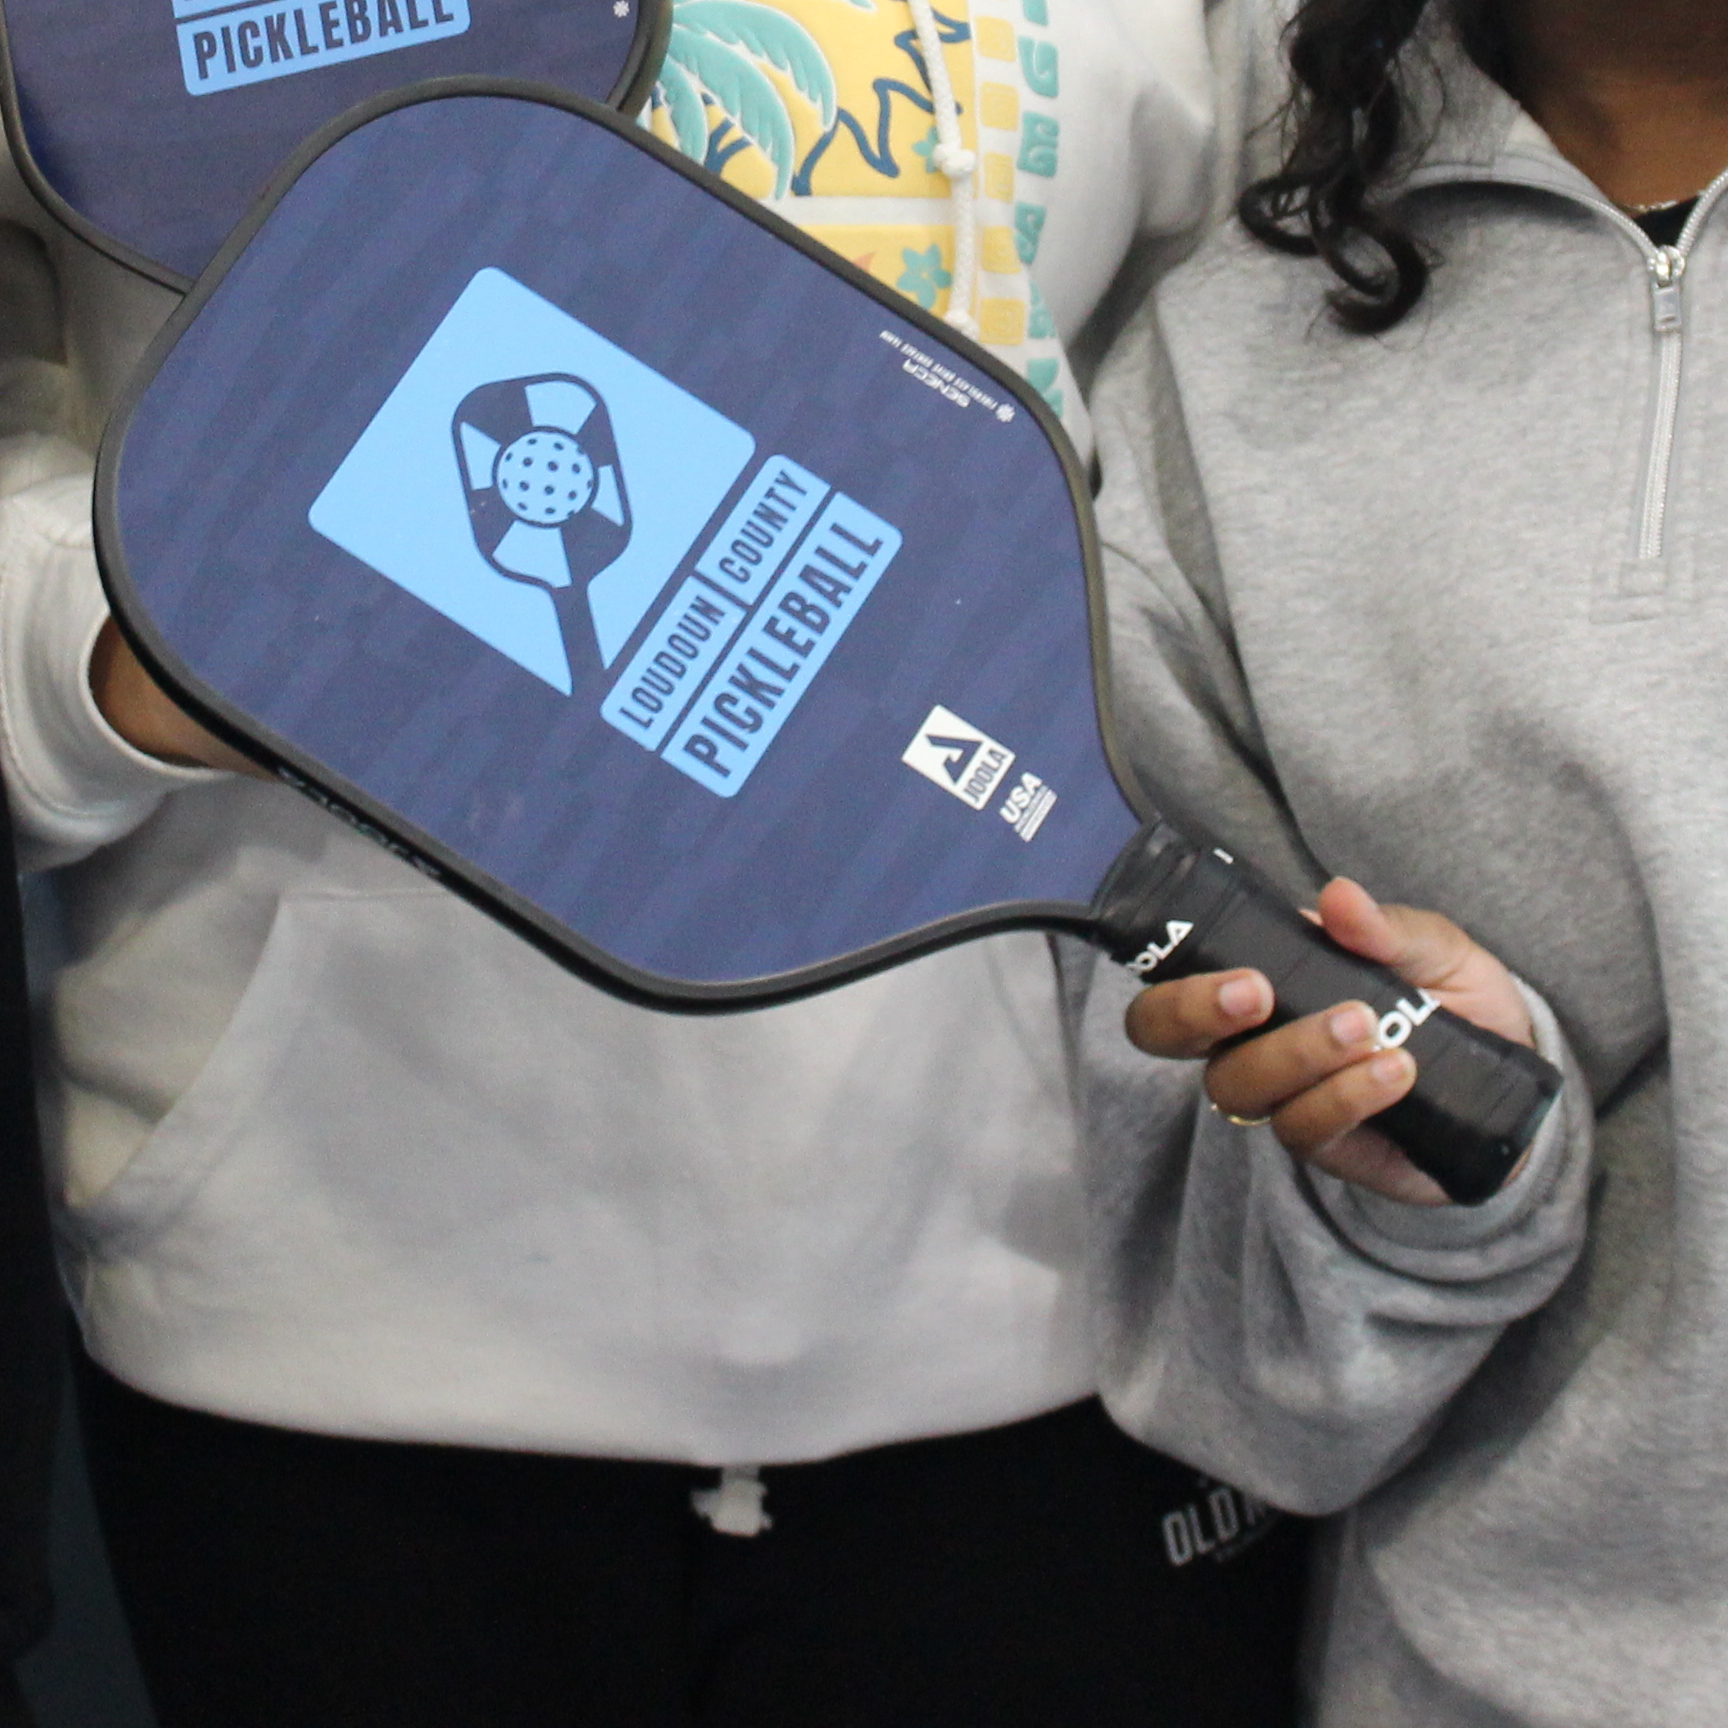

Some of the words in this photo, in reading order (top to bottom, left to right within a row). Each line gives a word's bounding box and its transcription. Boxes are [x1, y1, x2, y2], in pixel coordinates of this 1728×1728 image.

[618, 595, 726, 730] LOUDOUN
[718, 469, 808, 584] COUNTY
[682, 523, 884, 779] PICKLEBALL
[962, 748, 1008, 803] JOOLA
[999, 771, 1043, 824] USA
